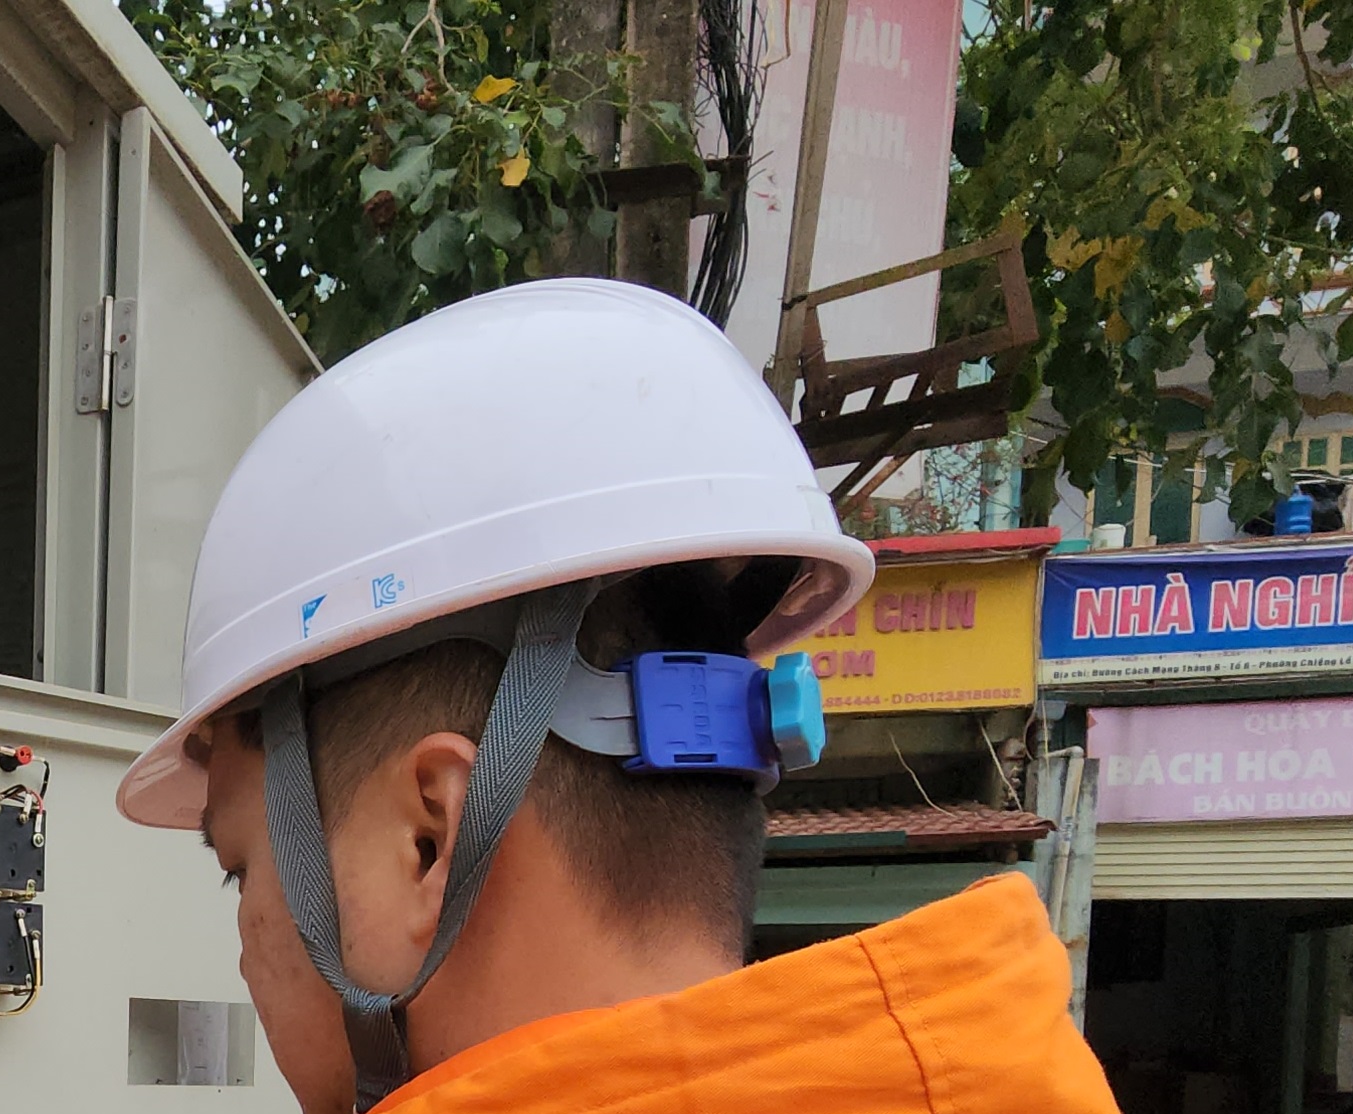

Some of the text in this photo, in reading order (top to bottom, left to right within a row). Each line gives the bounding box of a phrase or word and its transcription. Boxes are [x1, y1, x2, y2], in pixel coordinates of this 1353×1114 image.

[1073, 572, 1195, 640] NHÀ
[1106, 750, 1223, 786] BÁCH
[1193, 785, 1352, 813] BÁN BUÔN
